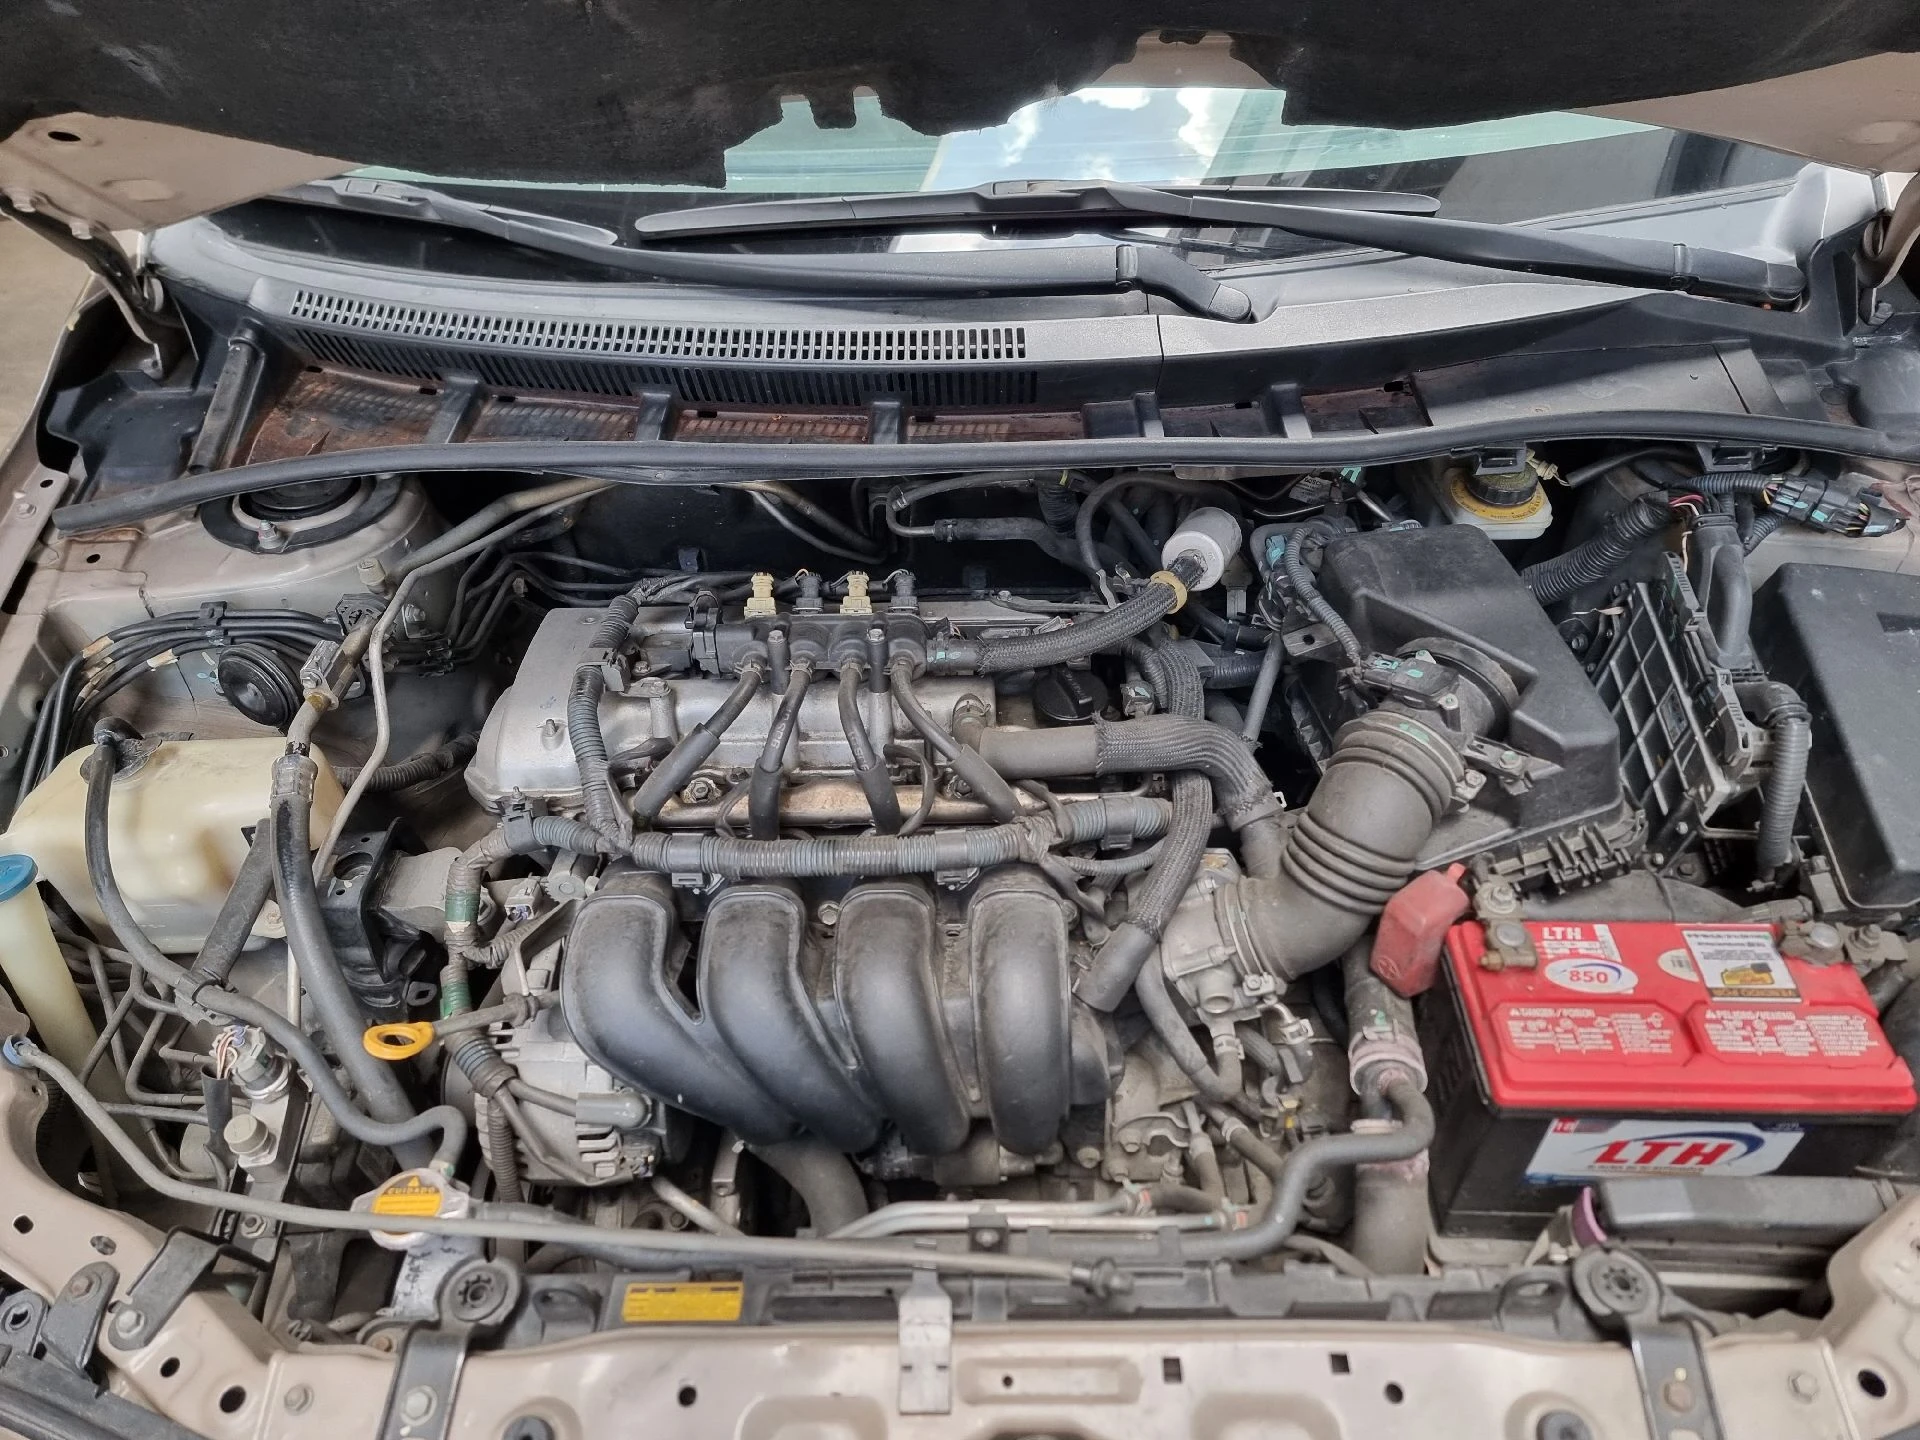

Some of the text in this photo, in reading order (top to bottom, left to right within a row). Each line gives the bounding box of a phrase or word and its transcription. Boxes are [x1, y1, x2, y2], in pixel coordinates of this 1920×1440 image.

[1543, 927, 1582, 940] LTH
[1569, 970, 1608, 984] 850
[1594, 1140, 1736, 1166] LTH
